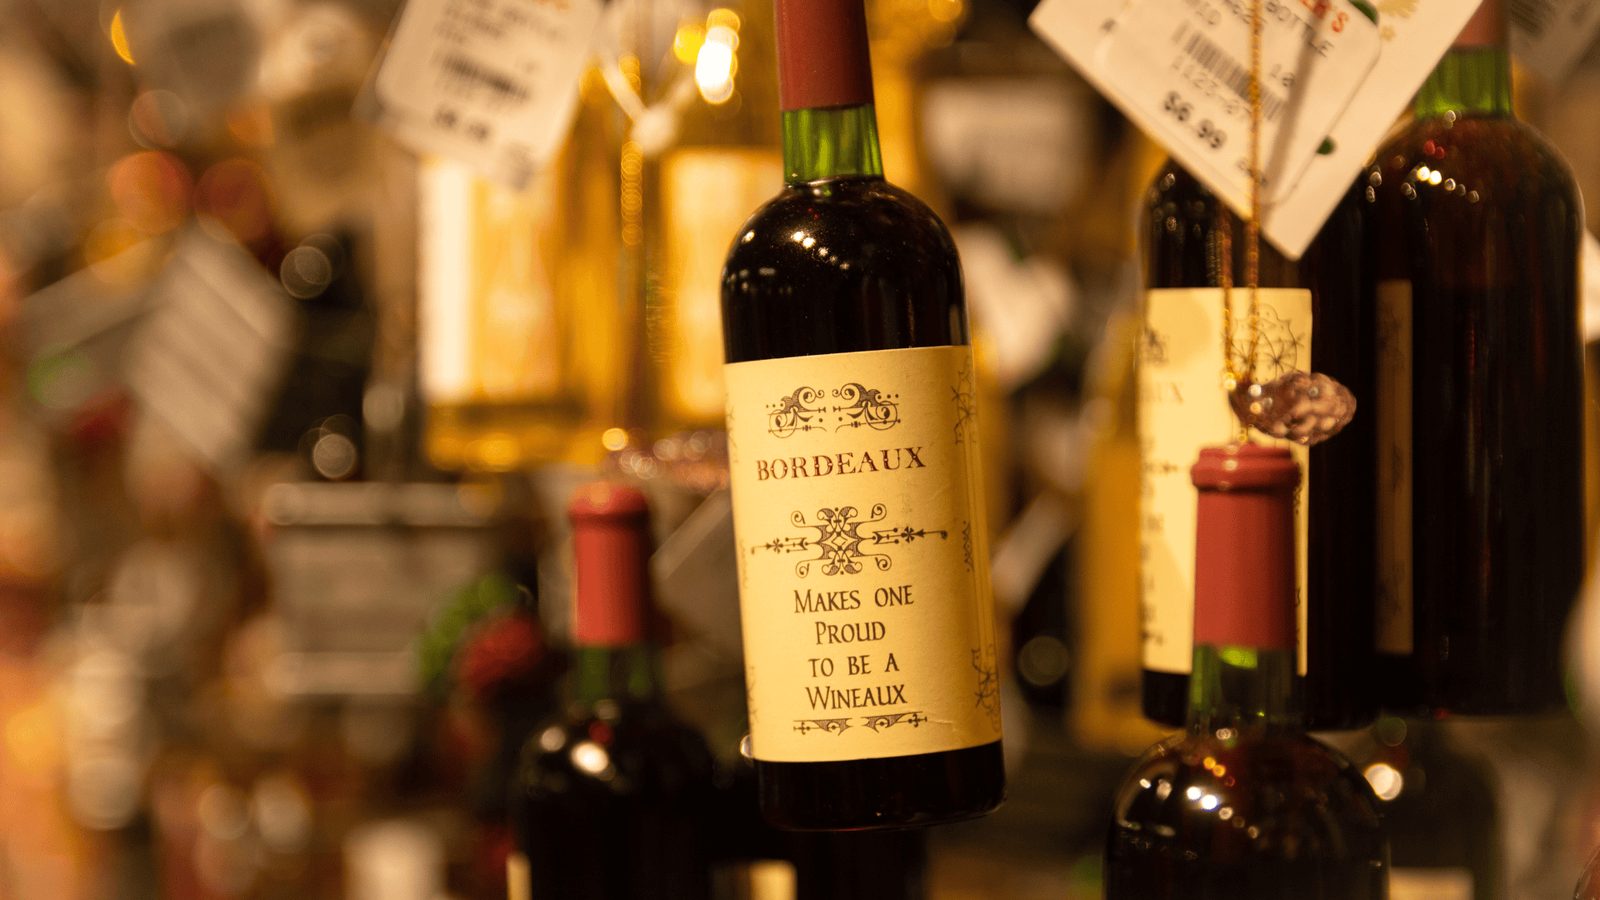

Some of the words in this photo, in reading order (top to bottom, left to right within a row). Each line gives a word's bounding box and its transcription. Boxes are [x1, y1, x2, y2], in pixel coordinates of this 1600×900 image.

[1163, 90, 1228, 150] $6.99
[757, 446, 926, 481] BORDEAUX
[794, 588, 862, 614] MAKES
[874, 584, 915, 608] ONE
[814, 620, 886, 646] PROUD
[808, 657, 835, 678] TO
[847, 654, 872, 676] BE
[884, 652, 900, 673] A
[805, 683, 908, 711] WINEAUX
